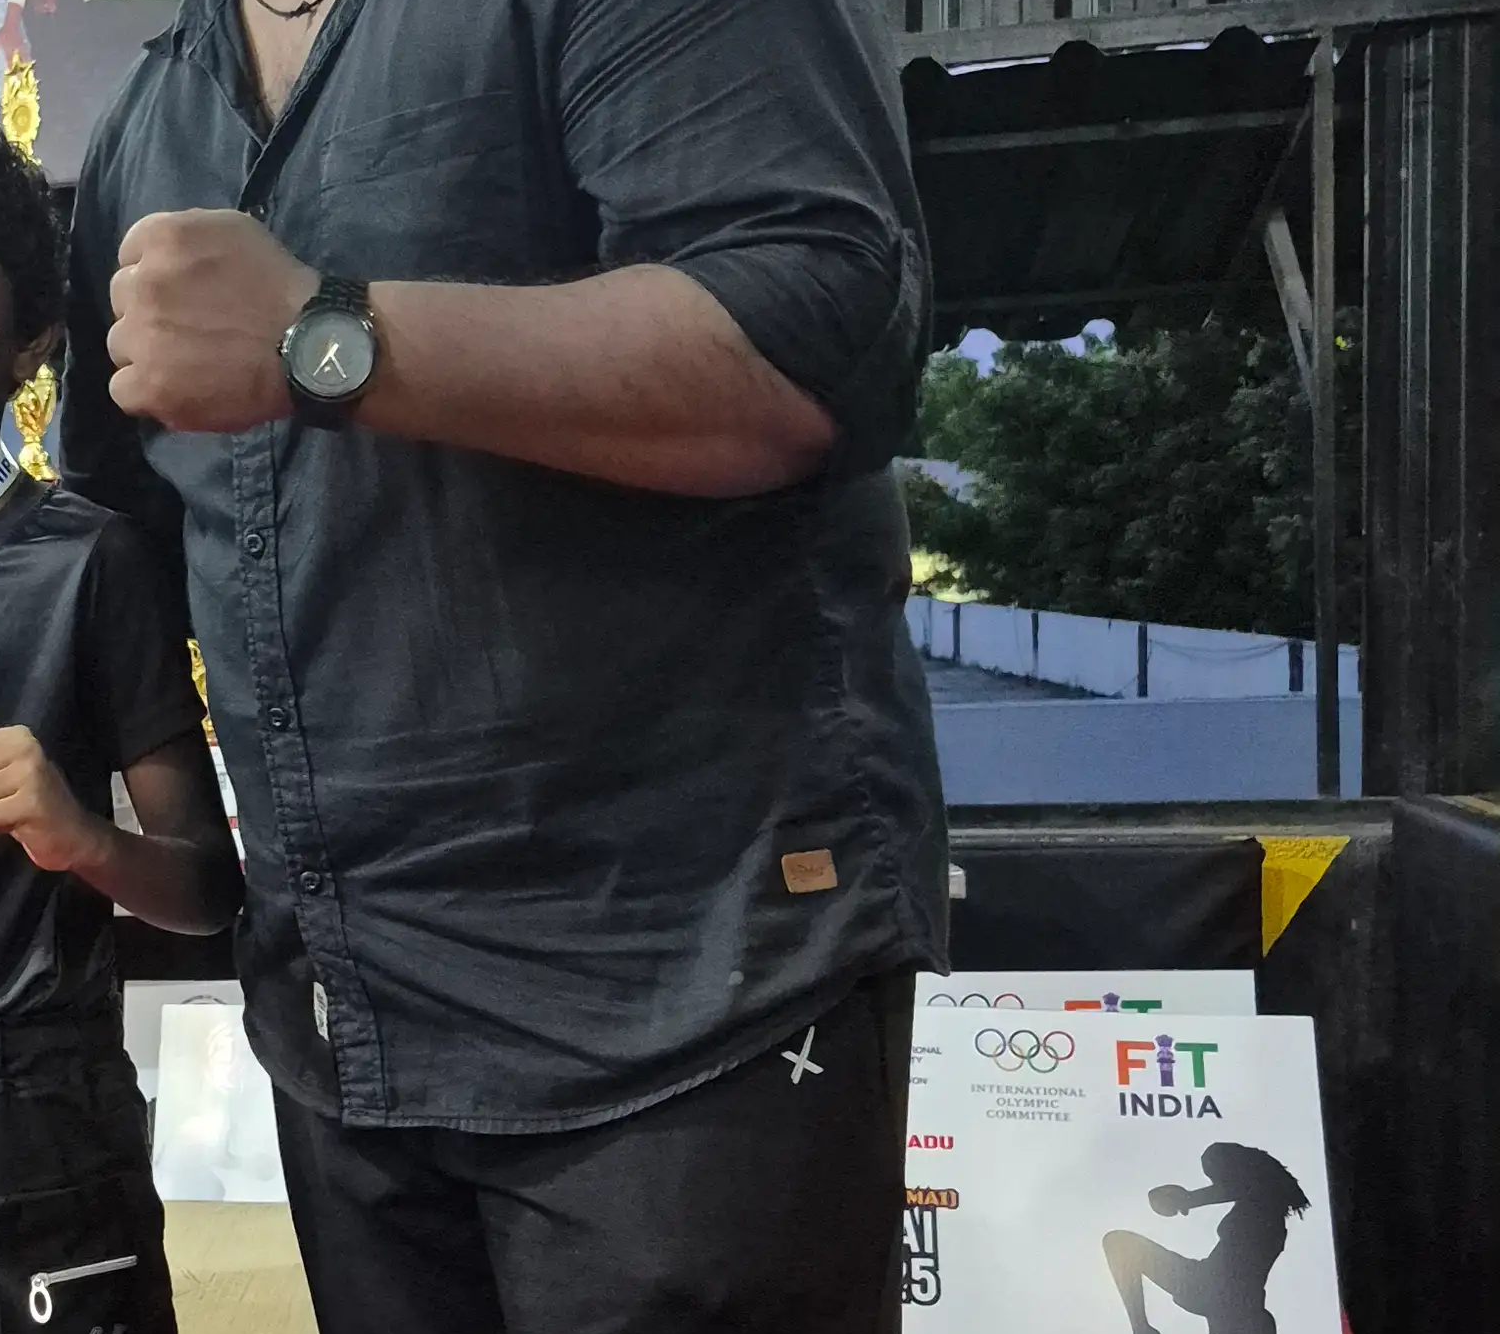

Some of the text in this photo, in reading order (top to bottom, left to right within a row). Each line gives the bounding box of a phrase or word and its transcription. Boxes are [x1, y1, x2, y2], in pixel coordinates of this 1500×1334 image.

[970, 1083, 1086, 1098] INTERNATIONAL
[995, 1097, 1060, 1110] OLYMPIC
[1119, 1091, 1223, 1119] INDIA
[985, 1109, 1072, 1123] COMMITTEE
[907, 1134, 955, 1150] ADU
[905, 1188, 958, 1208] MAI)
